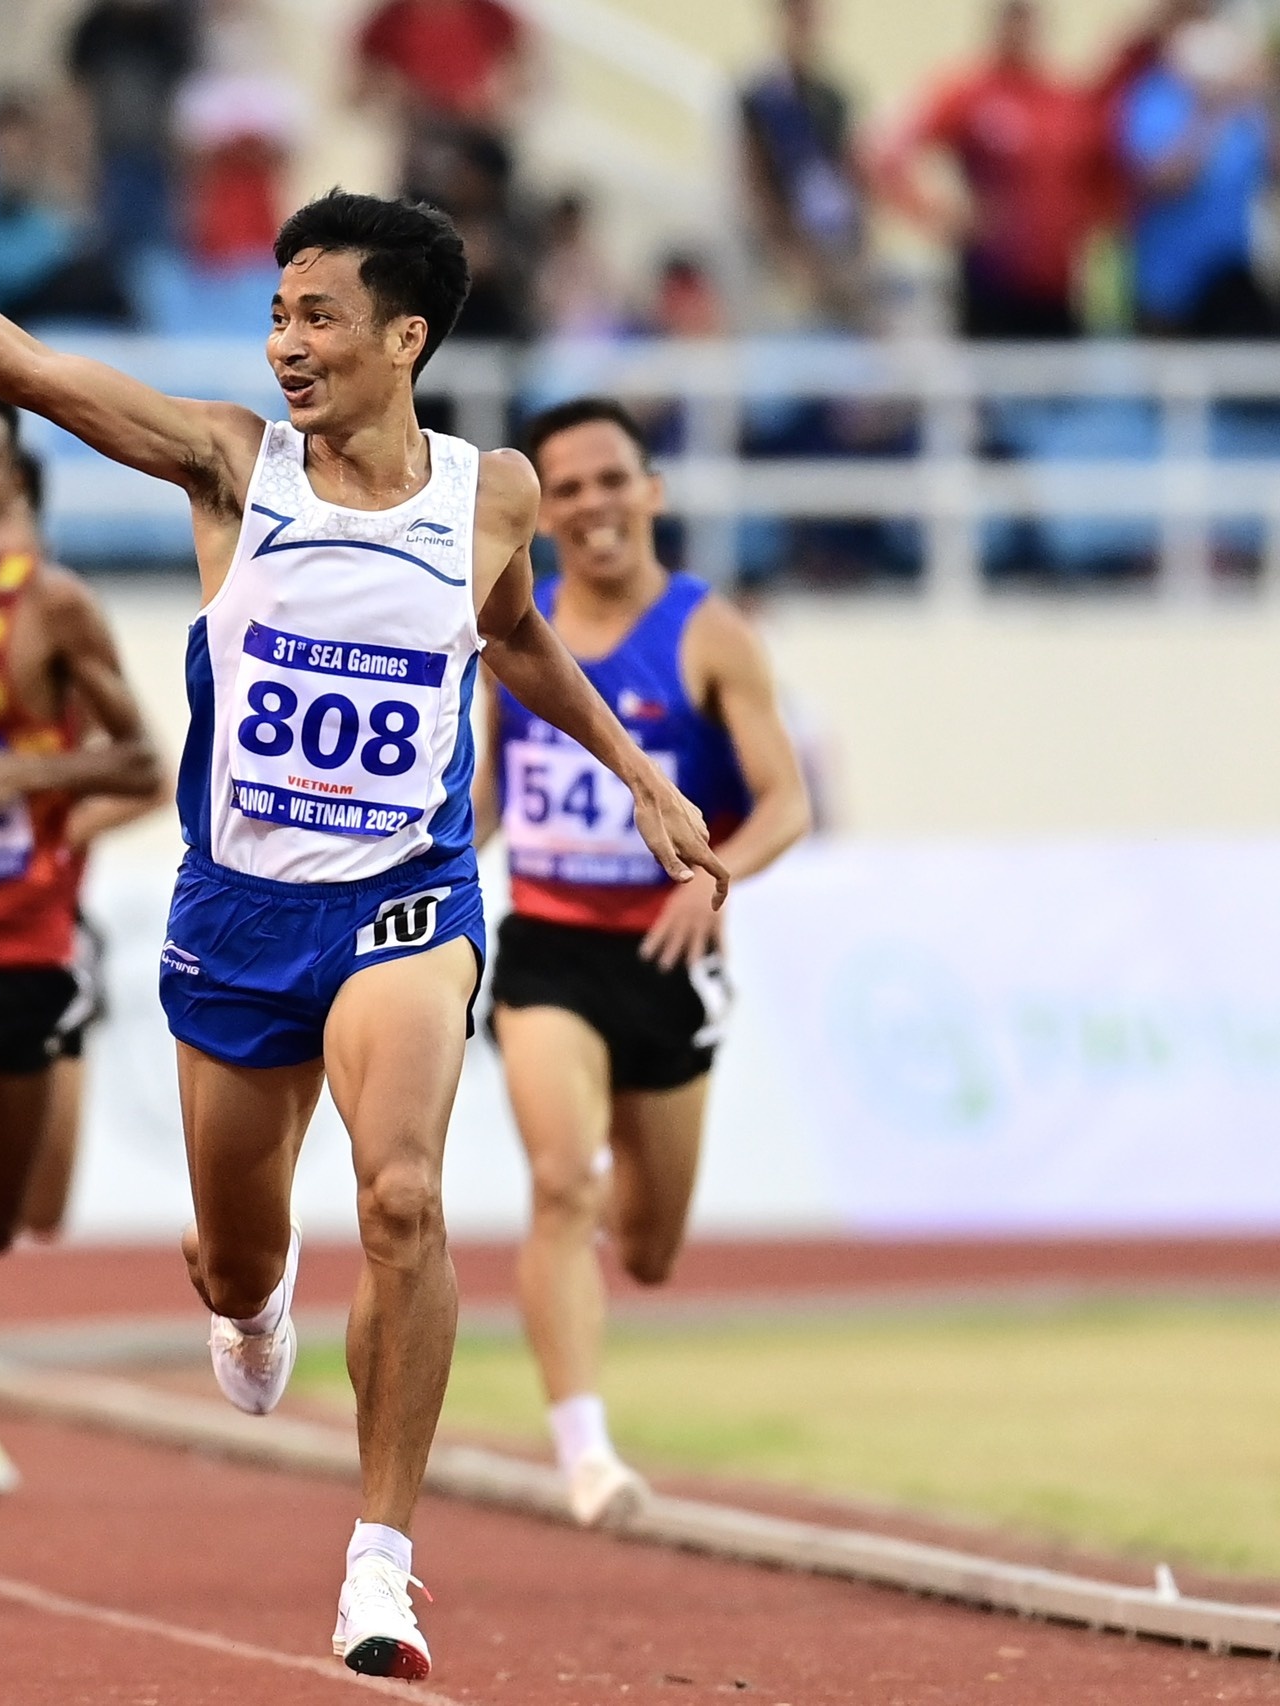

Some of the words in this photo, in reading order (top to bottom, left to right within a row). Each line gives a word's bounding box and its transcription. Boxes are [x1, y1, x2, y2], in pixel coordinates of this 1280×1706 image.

[406, 534, 454, 547] LI-NING
[308, 644, 343, 670] SEA
[347, 648, 409, 677] Games
[238, 680, 420, 776] 808
[287, 775, 354, 795] VIETNAM
[523, 763, 635, 829] 54
[236, 786, 276, 814] ANOI
[289, 796, 363, 828] VIETNAM
[365, 808, 408, 831] 2022
[373, 896, 439, 946] 10
